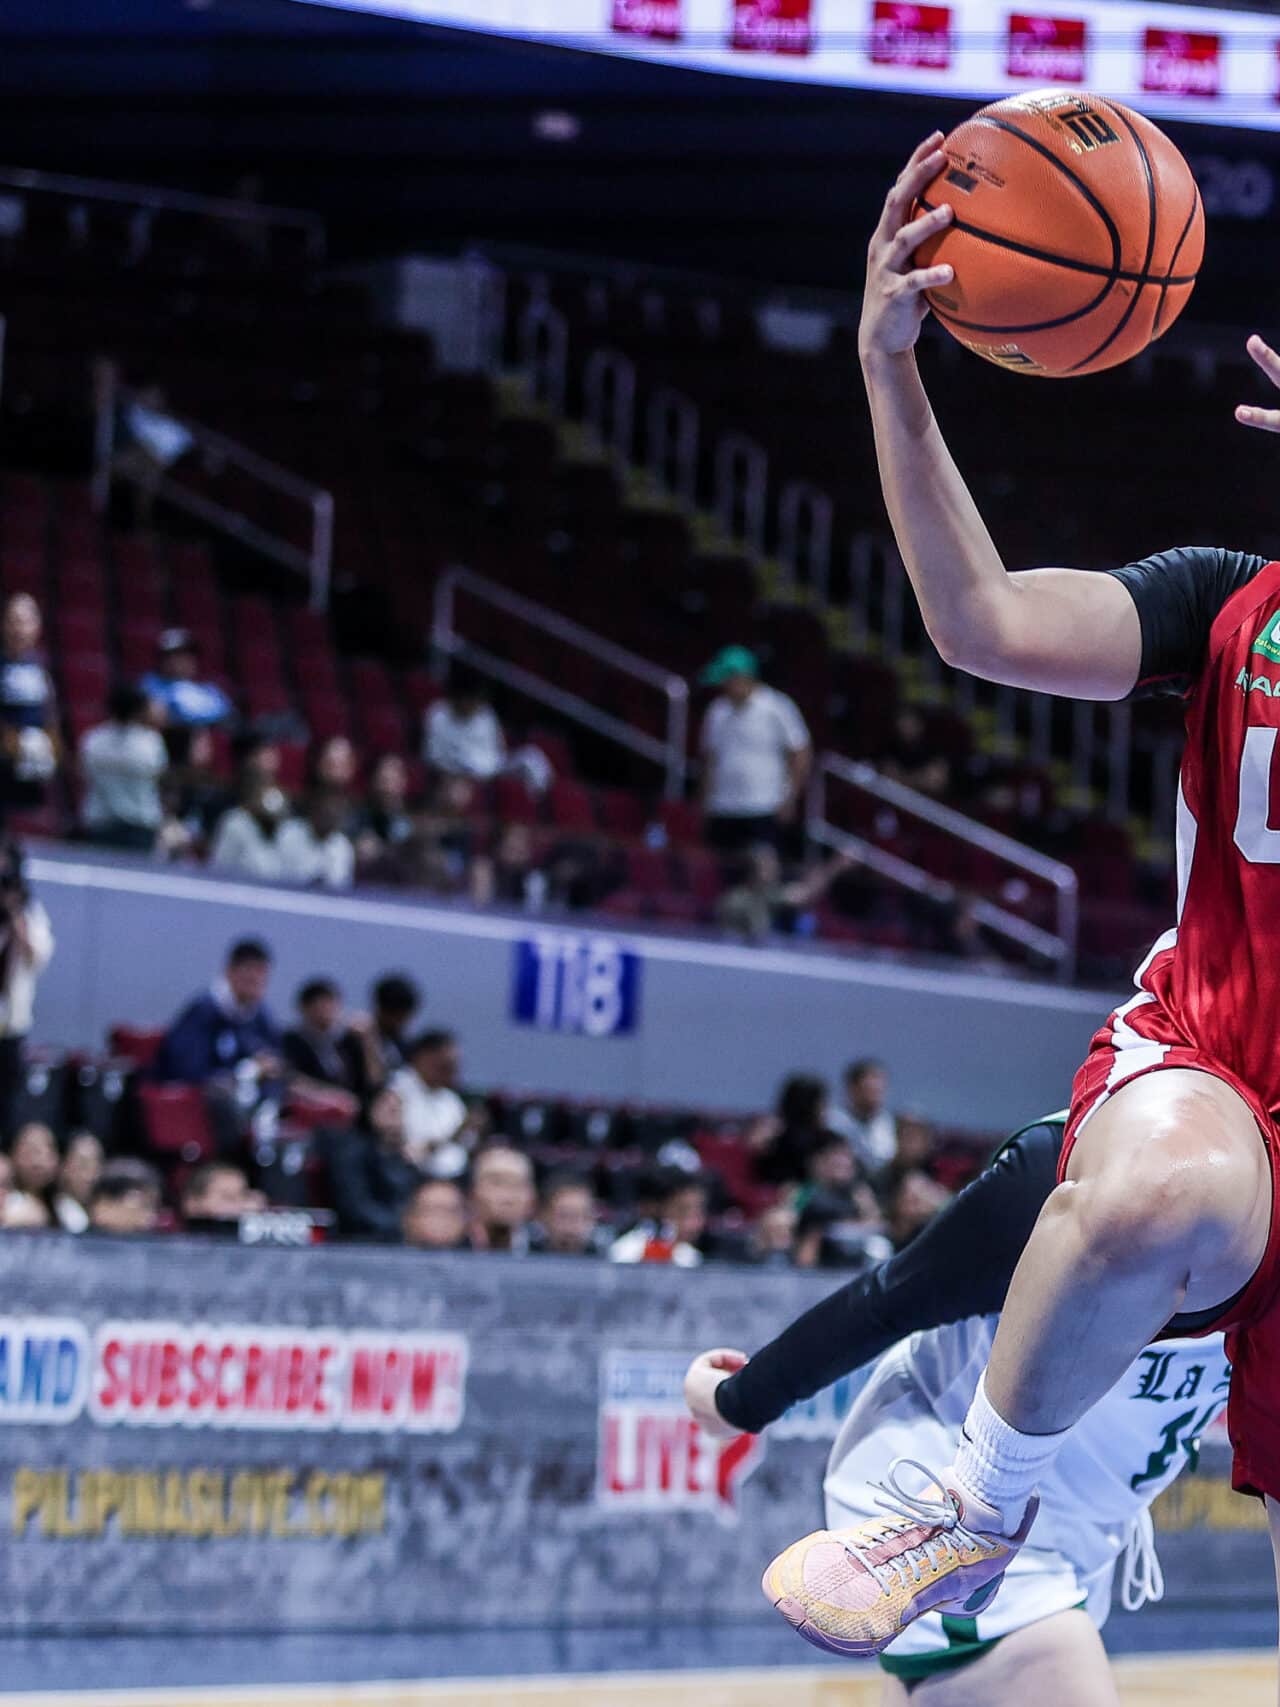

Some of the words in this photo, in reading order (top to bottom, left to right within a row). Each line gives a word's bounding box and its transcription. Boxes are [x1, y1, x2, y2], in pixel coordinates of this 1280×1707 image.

[532, 930, 625, 1037] 118
[100, 1339, 332, 1413] SUBSCRIBE
[1130, 1351, 1206, 1404] La
[604, 1415, 706, 1492] LIVE
